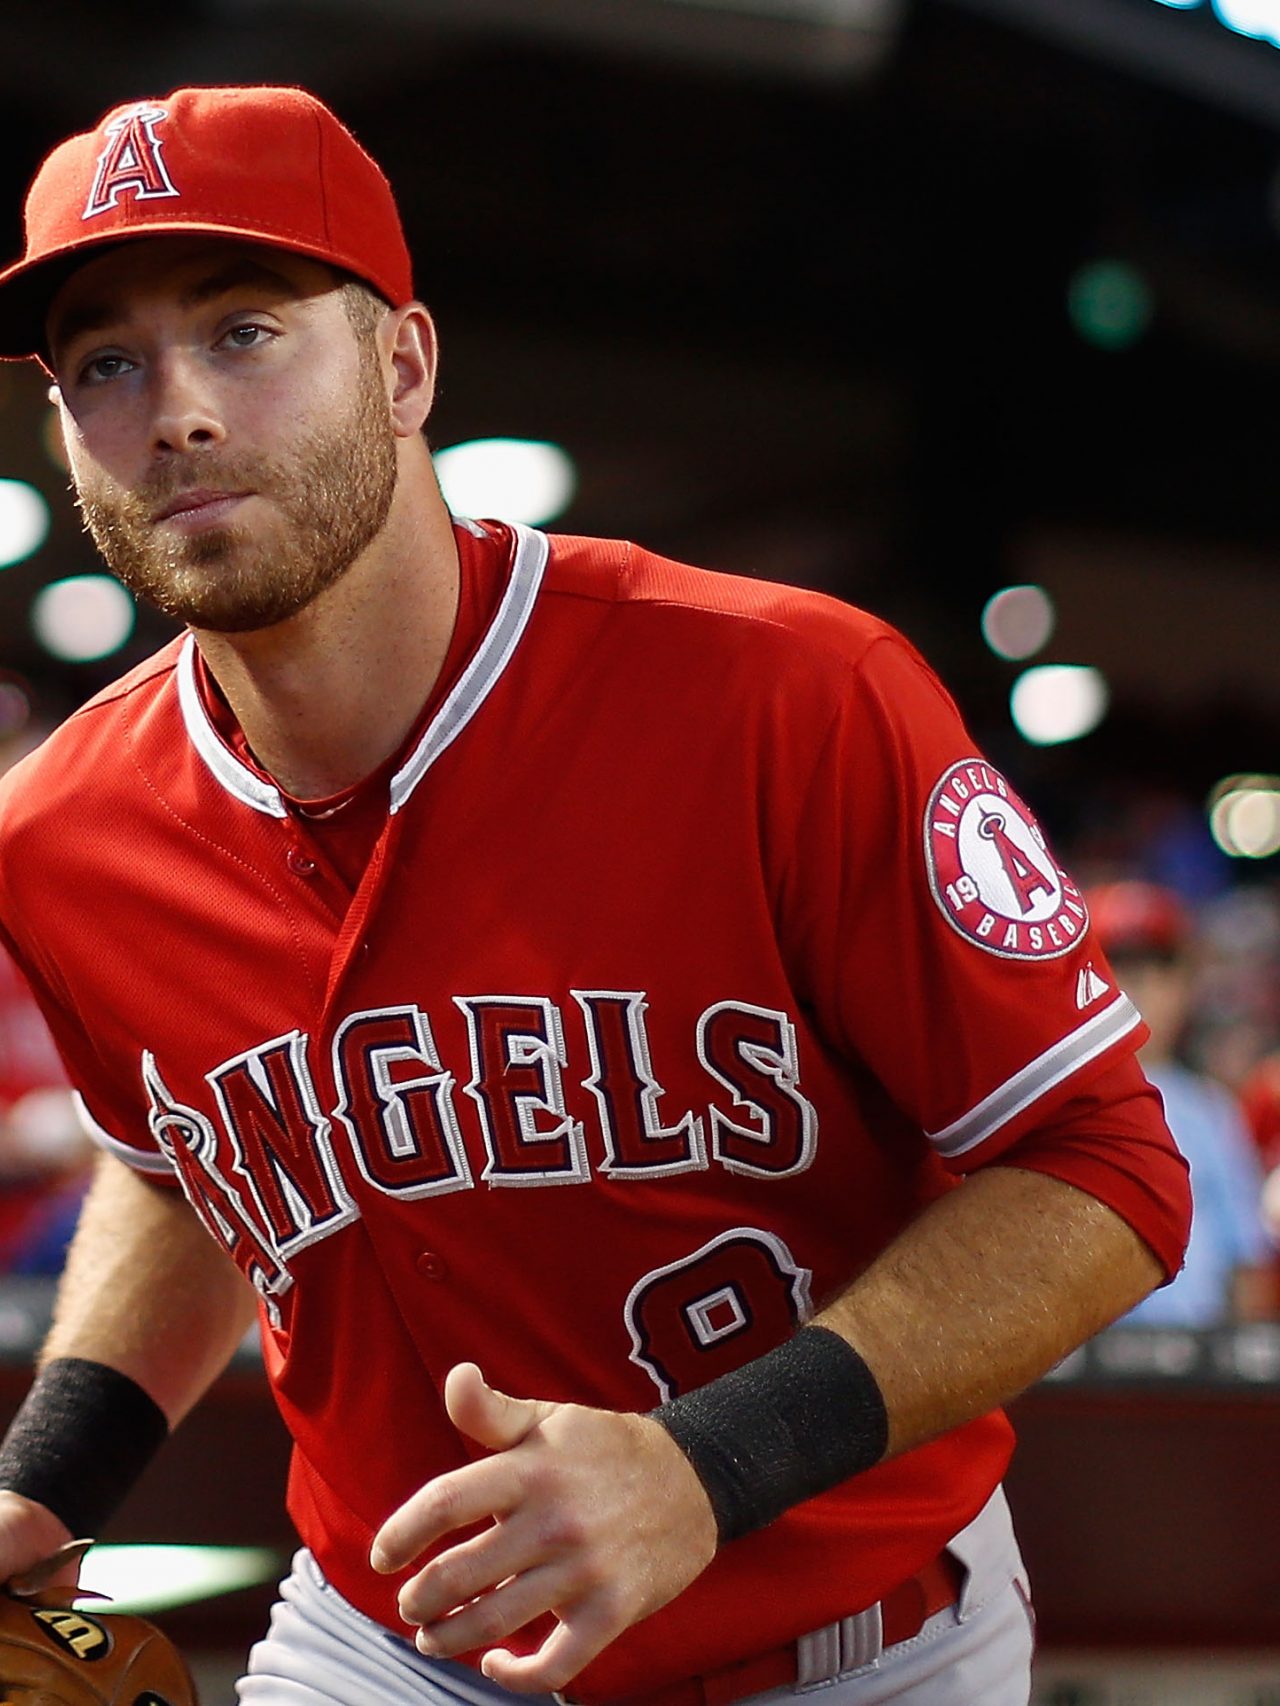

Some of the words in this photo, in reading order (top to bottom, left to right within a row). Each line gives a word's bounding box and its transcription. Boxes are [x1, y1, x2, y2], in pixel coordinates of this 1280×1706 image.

[933, 766, 1009, 838] ANGELS
[945, 875, 978, 911] 19
[142, 989, 818, 1330] ANGELS
